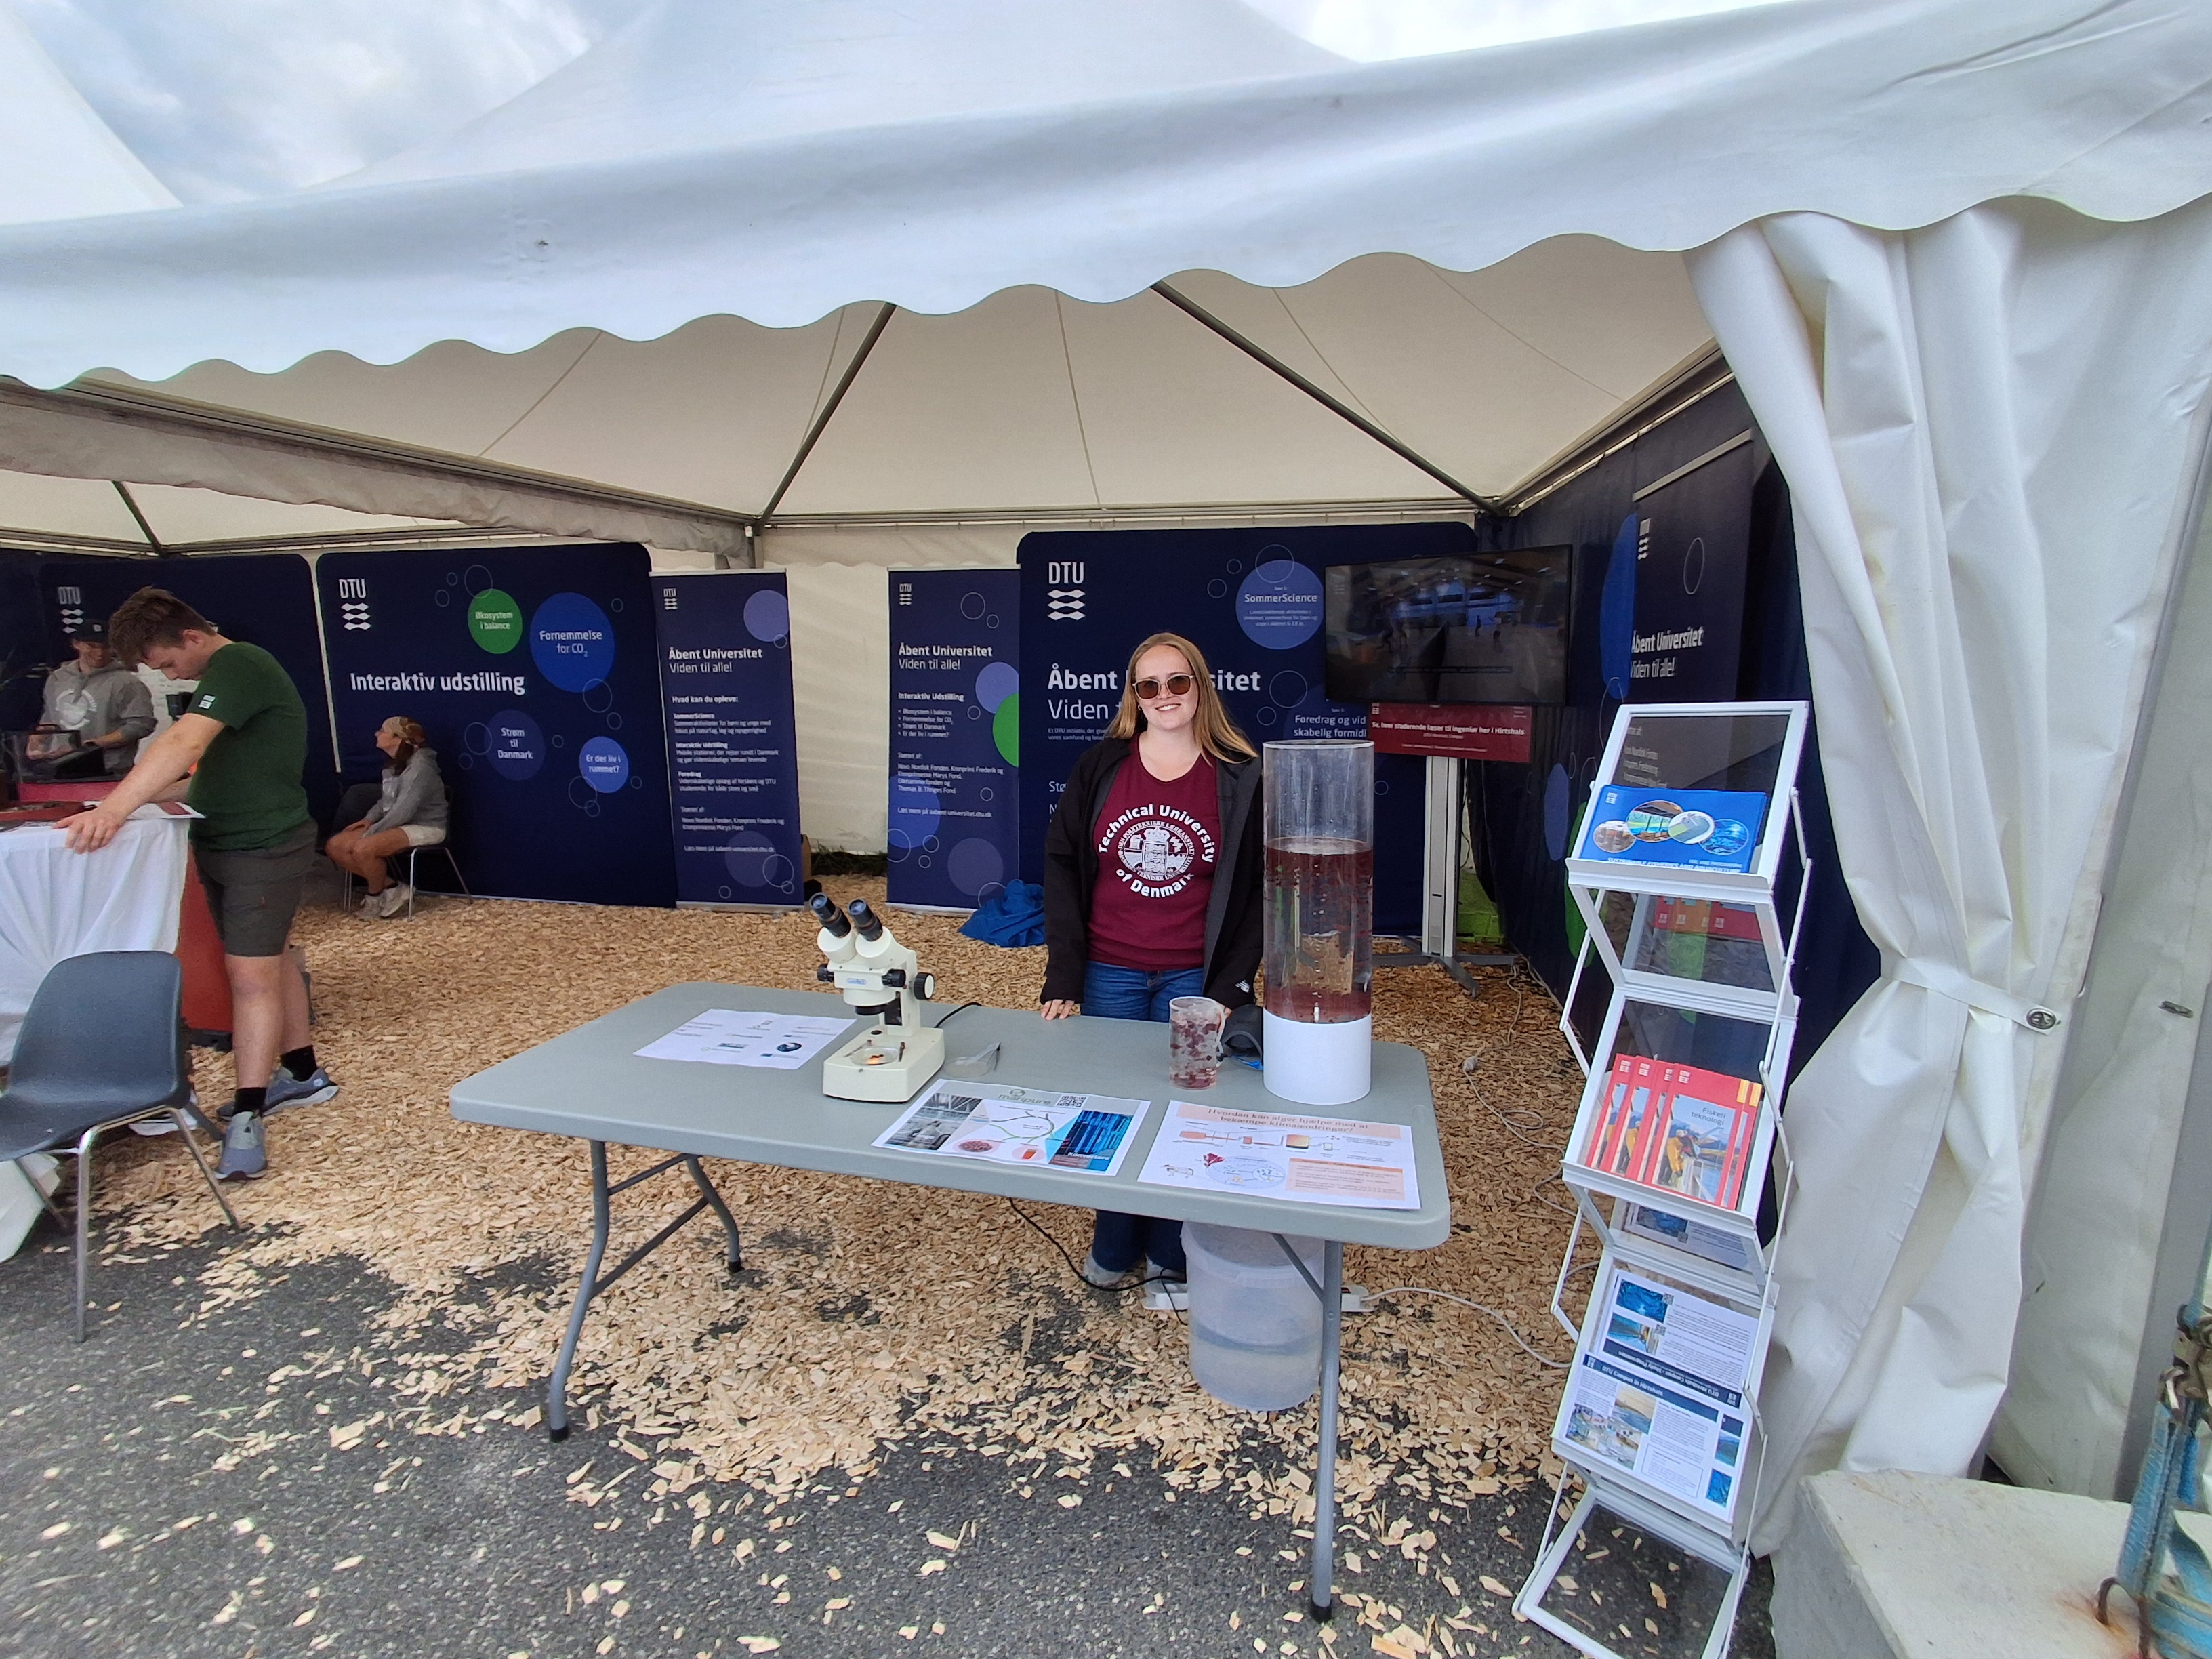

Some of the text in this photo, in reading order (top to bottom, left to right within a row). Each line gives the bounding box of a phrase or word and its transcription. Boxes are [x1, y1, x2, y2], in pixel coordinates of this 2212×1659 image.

[1048, 562, 1084, 584] DTU
[339, 579, 366, 599] DTU
[663, 588, 676, 597] DTU
[899, 583, 912, 592] DTU
[58, 587, 81, 605] DTU
[1244, 594, 1317, 602] SommerScience
[475, 611, 513, 620] Økosystem
[539, 630, 602, 640] Fornemmelse
[1631, 626, 1704, 653] Åbent Universitet
[556, 644, 570, 653] for
[669, 647, 763, 660] Åbent Universitet
[899, 642, 993, 657] Åbent Universitet
[669, 662, 733, 673] Viden til alle!
[899, 659, 961, 670] Viden til alle!
[1048, 663, 1118, 689] Åbent
[350, 673, 525, 695] Interaktiv udstilling
[898, 692, 964, 702] Interaktiv Udstilling
[1048, 699, 1109, 719] Viden
[1295, 715, 1366, 725] Foredrag og vid
[501, 727, 525, 737] Strøm
[1294, 728, 1367, 738] skabelig formidl
[510, 739, 518, 747] til
[497, 750, 533, 759] Danmark
[595, 754, 607, 762] der
[1049, 781, 1066, 792] Stø
[1099, 803, 1154, 854] Technical
[1159, 804, 1216, 863] University
[1116, 869, 1195, 897] of Denmark
[998, 1094, 1051, 1105] maripure
[1208, 1109, 1249, 1118] Hvordan
[1272, 1115, 1296, 1124] alger
[1299, 1118, 1333, 1126] hjælpe
[1702, 1107, 1726, 1118] Fiskeri
[1220, 1116, 1267, 1126] bekæmpe
[1692, 1112, 1724, 1126] teknologi
